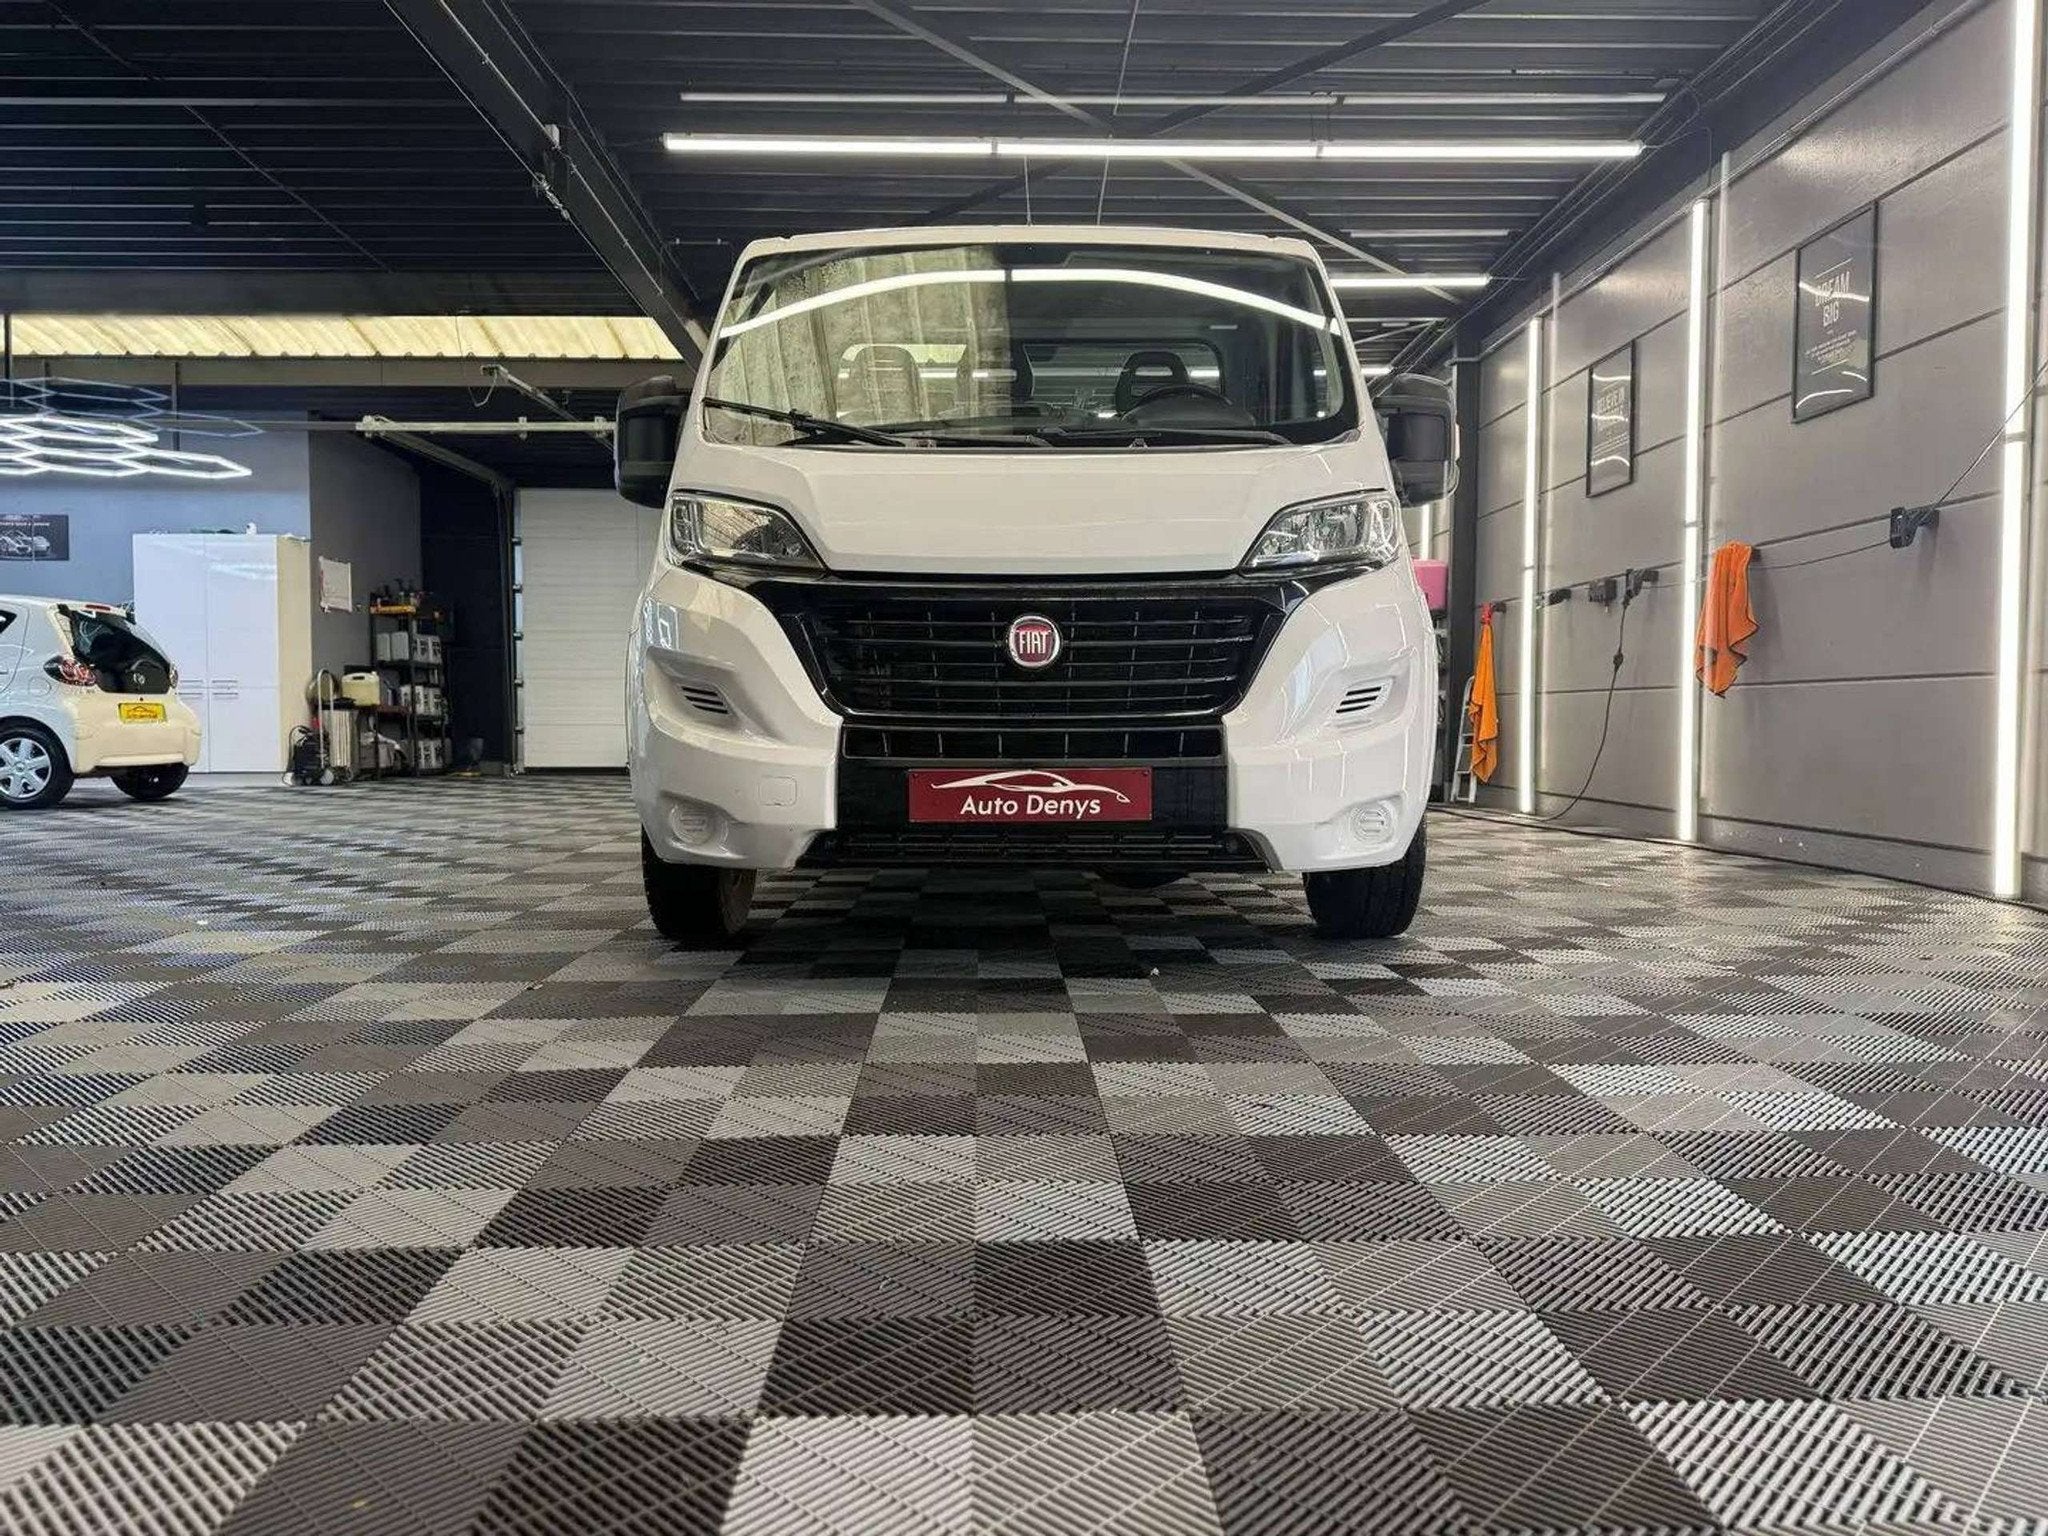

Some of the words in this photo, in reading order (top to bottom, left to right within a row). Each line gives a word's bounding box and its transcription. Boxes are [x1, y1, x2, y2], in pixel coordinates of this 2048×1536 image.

[1016, 630, 1052, 654] FIAT
[960, 795, 1018, 815] Auto
[1026, 794, 1101, 819] Denys
